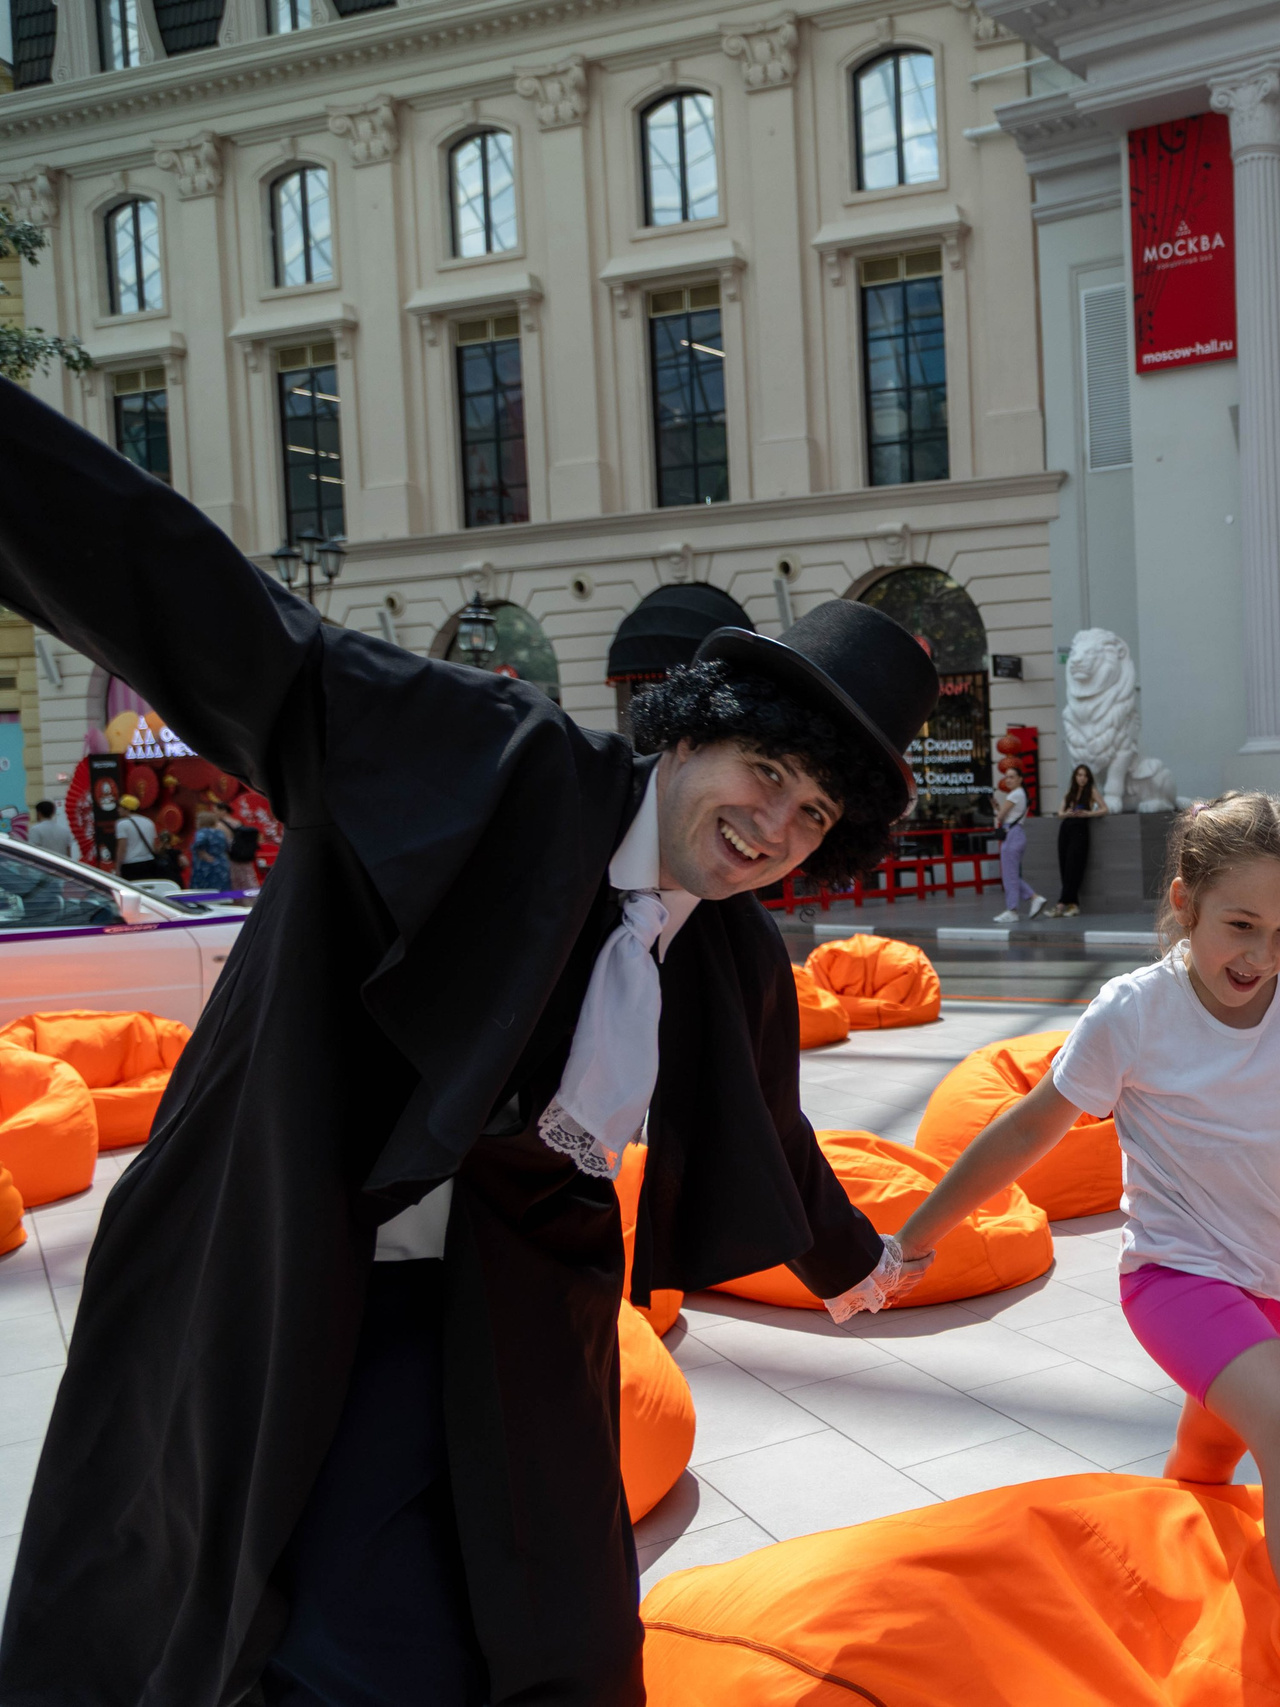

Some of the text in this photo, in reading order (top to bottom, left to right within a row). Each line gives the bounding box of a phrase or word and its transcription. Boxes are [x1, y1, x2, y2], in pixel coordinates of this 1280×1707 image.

[1143, 232, 1226, 263] МОСКВА
[1142, 339, 1233, 365] moscow-hall.ru
[924, 737, 974, 752] Скидка
[925, 772, 975, 785] Скидка
